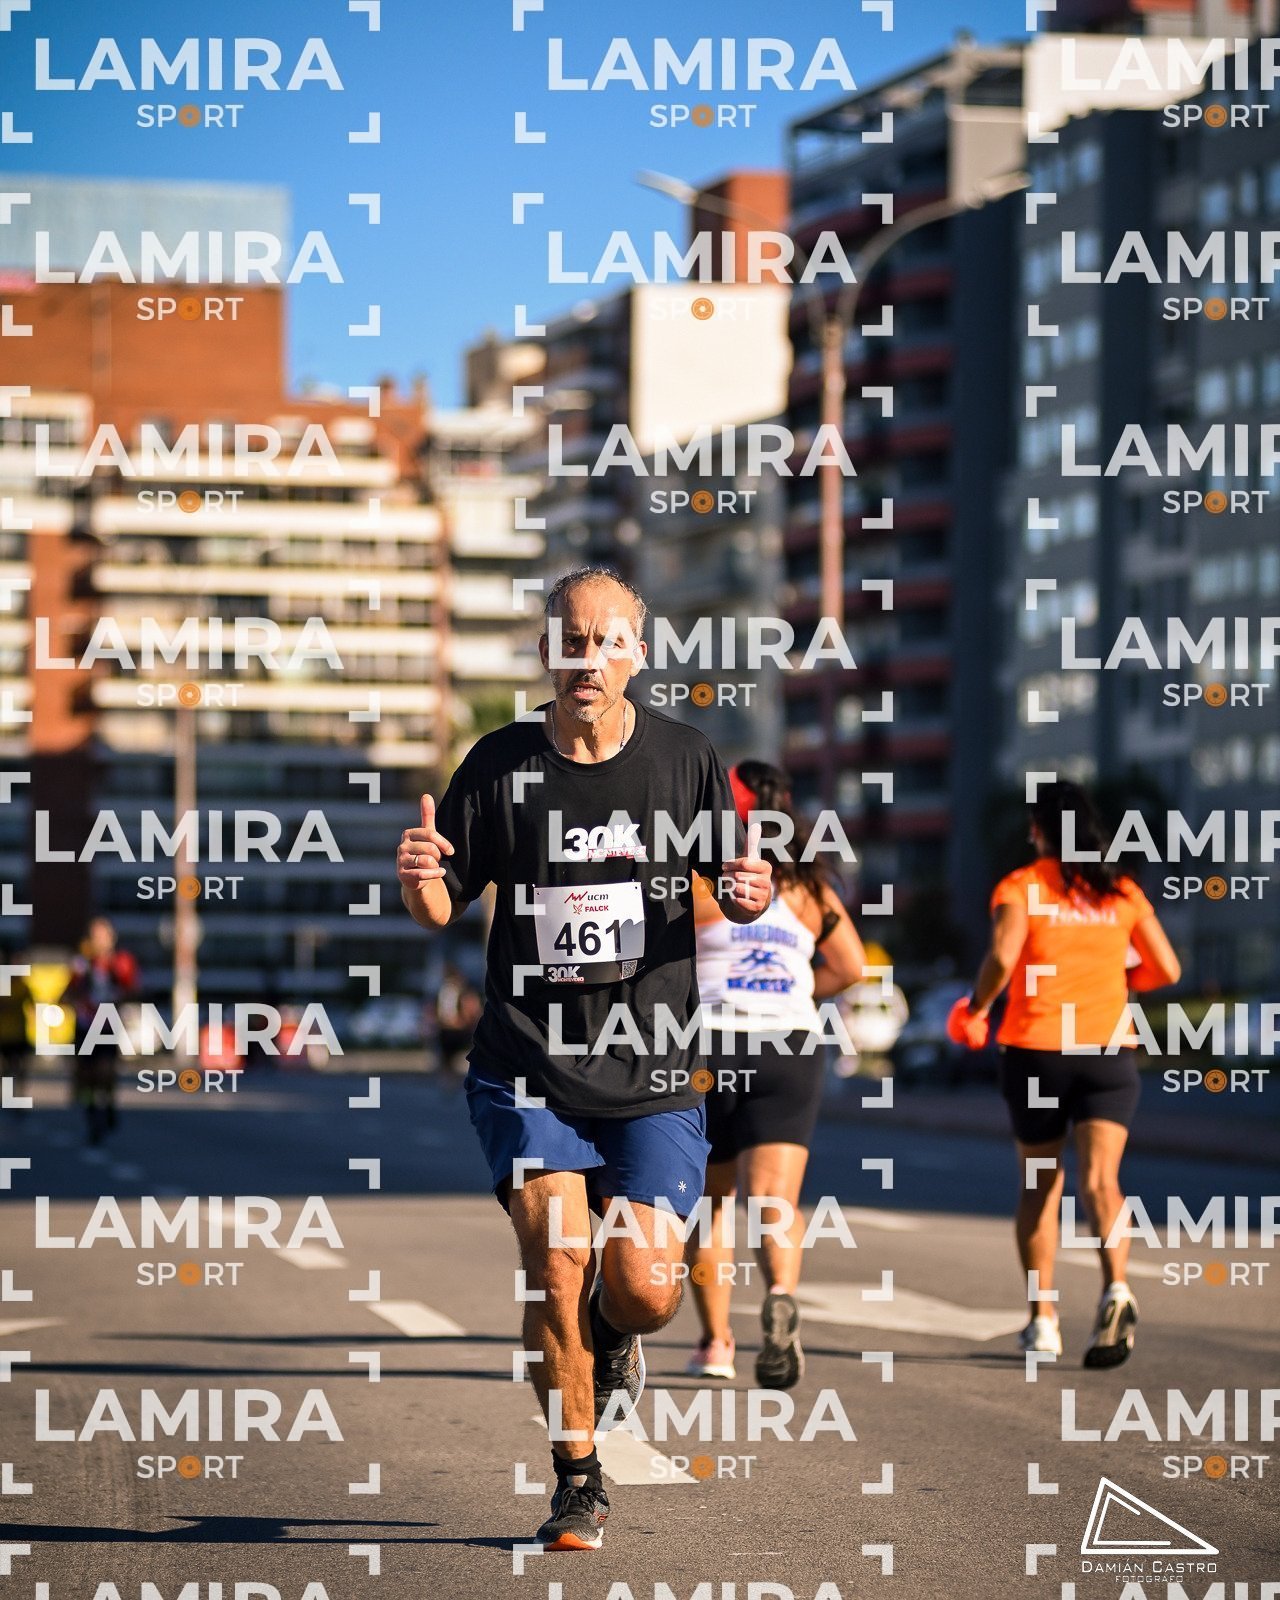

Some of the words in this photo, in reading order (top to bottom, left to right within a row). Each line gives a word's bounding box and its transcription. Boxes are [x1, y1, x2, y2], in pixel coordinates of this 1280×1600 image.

[564, 824, 640, 860] 30K
[587, 893, 609, 901] ucm
[585, 905, 609, 913] FALCK
[554, 919, 622, 957] 461
[547, 965, 580, 983] 30K
